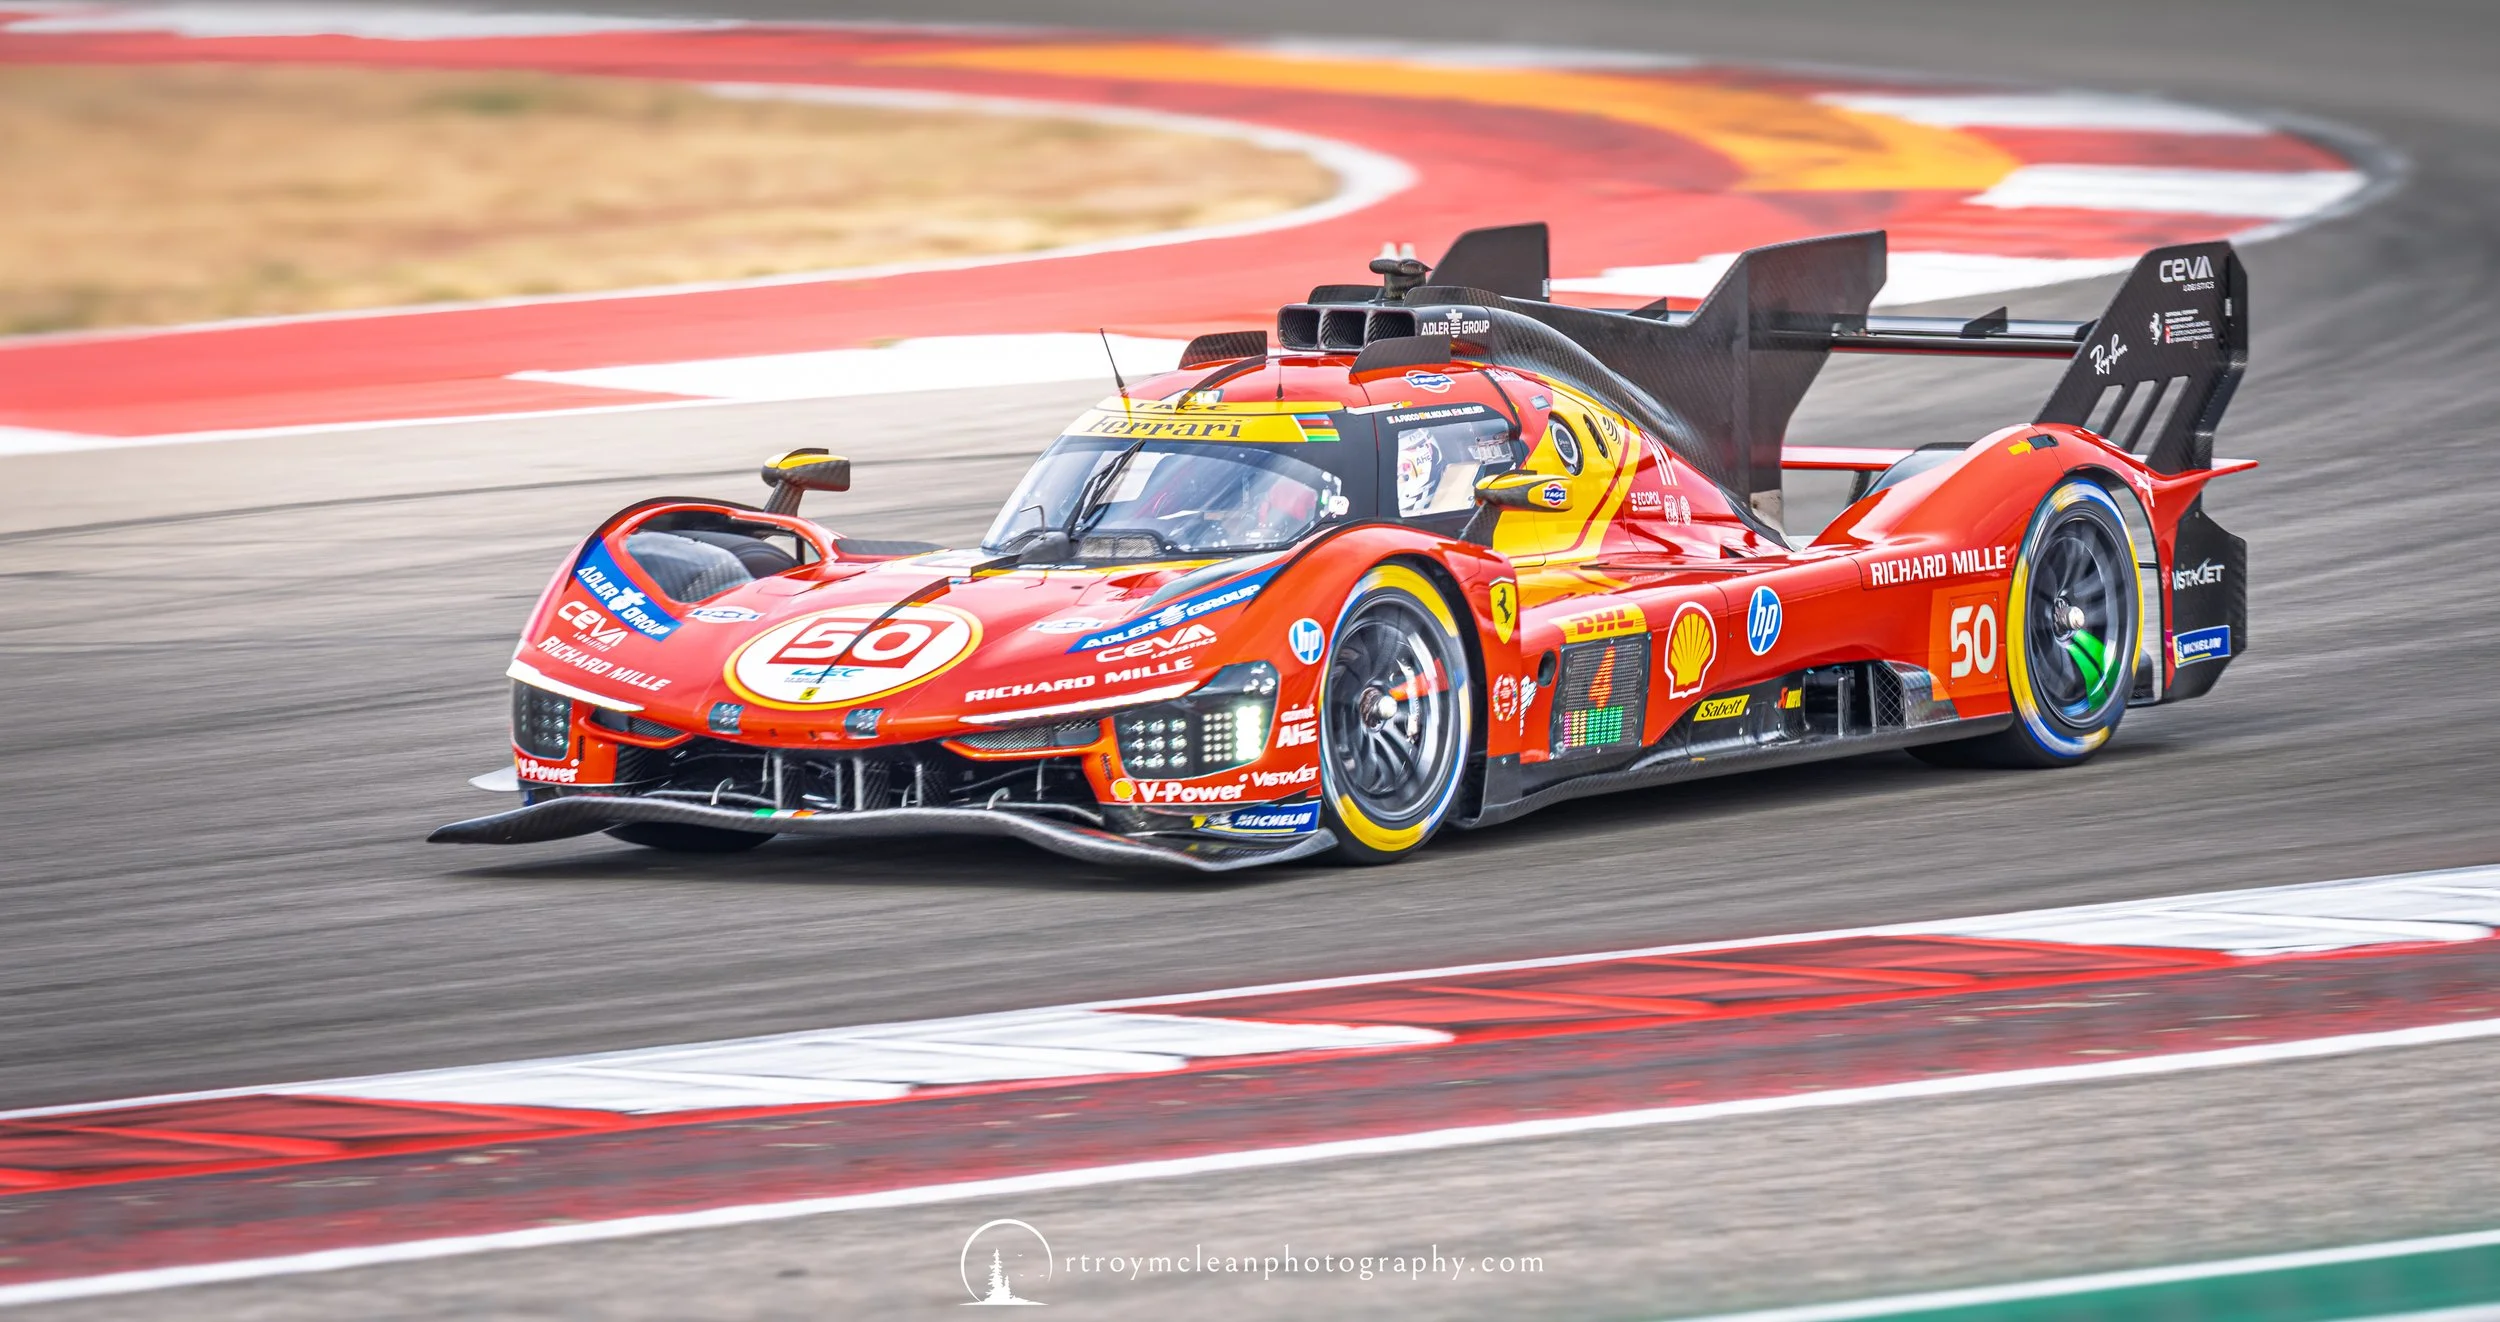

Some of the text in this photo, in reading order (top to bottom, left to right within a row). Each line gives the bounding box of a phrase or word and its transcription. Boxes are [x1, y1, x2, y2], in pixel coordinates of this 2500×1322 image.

[1421, 320, 1490, 336] ADLER GROUP
[2090, 333, 2128, 375] Ray-Ban
[1085, 416, 1243, 438] Ferrari
[1637, 491, 1661, 505] ECOPOL
[1870, 546, 2007, 586] RICHARD MILLE
[577, 565, 671, 635] ADLER GROUP
[1082, 584, 1261, 649] ADLER GROUP
[779, 621, 932, 661] 50
[1570, 609, 1635, 635] DHL
[1751, 588, 1778, 654] hp
[1951, 603, 1997, 678] 50
[1150, 636, 1217, 659] LOGISTICS
[1295, 619, 1321, 664] hp
[537, 635, 672, 691] RICHARD MILLE
[965, 656, 1195, 702] RICHARD MILLE
[1589, 645, 1616, 711] 4
[1701, 700, 1742, 718] Sabelt
[518, 757, 578, 782] V-Power
[1138, 780, 1247, 803] V-Power
[1235, 812, 1312, 827] MICHELIN
